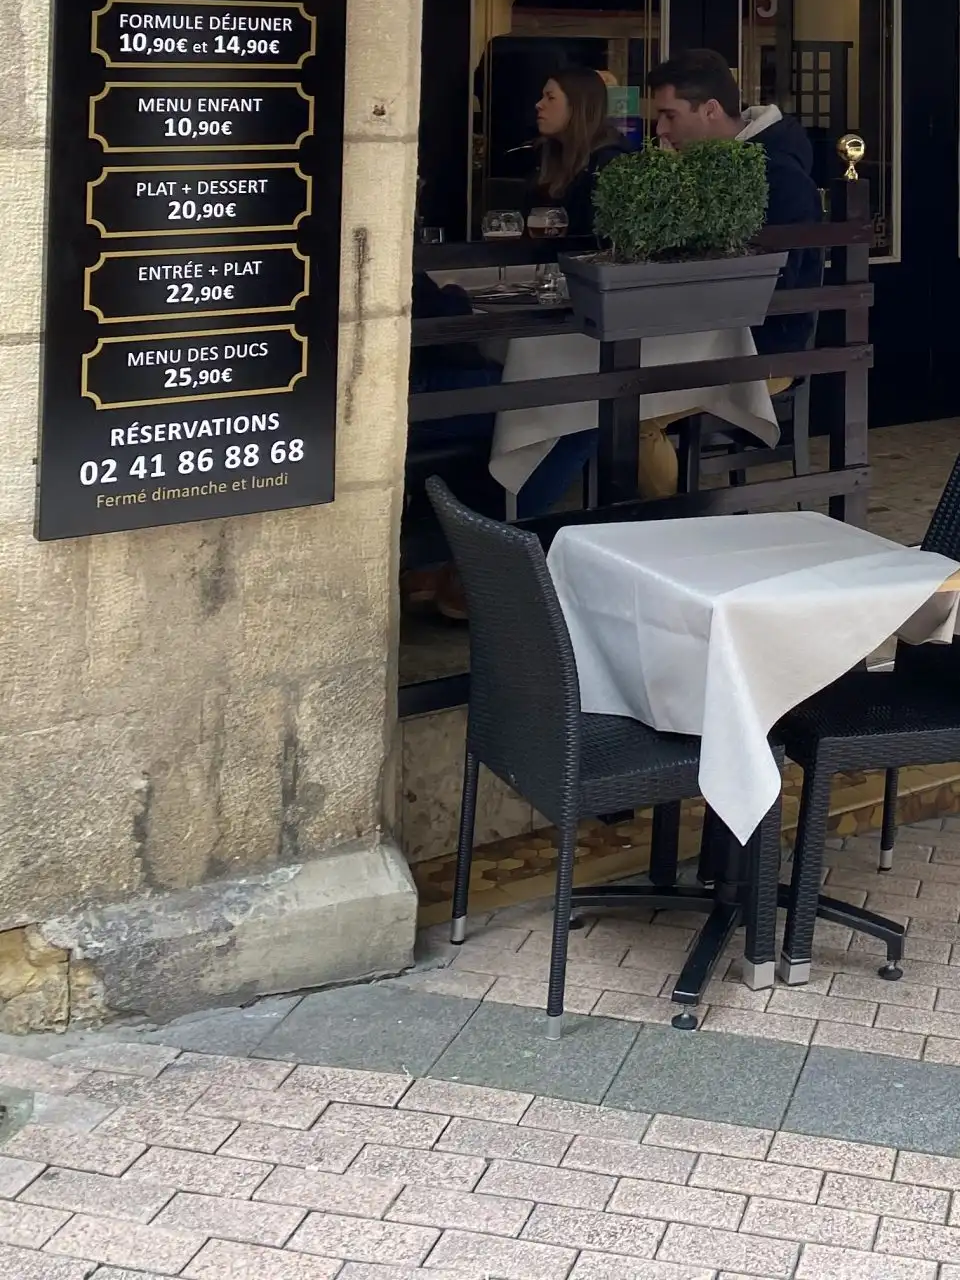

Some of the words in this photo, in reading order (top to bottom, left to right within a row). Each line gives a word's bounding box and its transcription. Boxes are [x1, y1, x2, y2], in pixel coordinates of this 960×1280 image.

[119, 13, 204, 31] FORMULE
[208, 12, 293, 32] DÉJEUNER
[119, 33, 188, 57] 10,90€
[192, 40, 208, 54] et
[213, 35, 280, 58] 14,90€
[138, 98, 192, 113] MENU
[197, 98, 263, 113] ENFANT
[164, 118, 233, 139] 10,90€
[136, 181, 175, 197] PLAT
[181, 184, 192, 195] +
[197, 179, 268, 195] DESSERT
[168, 200, 237, 221] 20,90€
[138, 261, 203, 282] ENTRÉE
[208, 266, 218, 276] +
[223, 261, 262, 276] PLAT
[166, 283, 234, 305] 22,90€
[127, 349, 181, 367] MENU
[187, 346, 219, 363] DES
[224, 342, 268, 358] DUCS
[164, 368, 233, 389] 25,90€
[110, 412, 280, 447] RÉSERVATIONS
[79, 459, 118, 486] 02
[129, 453, 166, 480] 41
[178, 448, 214, 475] 86
[224, 443, 260, 469] 88
[270, 438, 305, 464] 68
[96, 488, 147, 509] Fermé
[151, 480, 228, 503] dimanche
[231, 477, 247, 491] et
[252, 472, 288, 489] lundi
